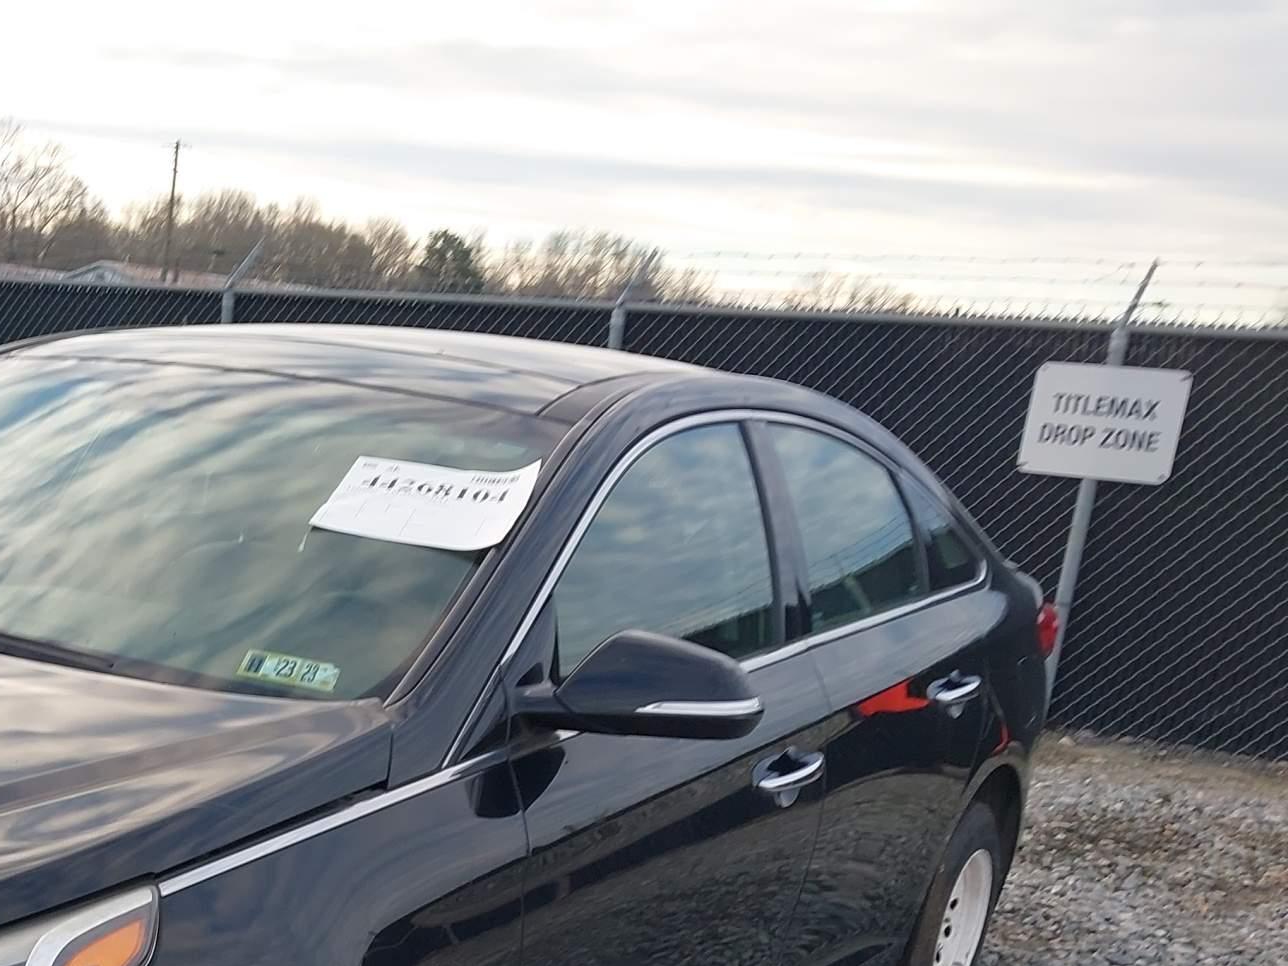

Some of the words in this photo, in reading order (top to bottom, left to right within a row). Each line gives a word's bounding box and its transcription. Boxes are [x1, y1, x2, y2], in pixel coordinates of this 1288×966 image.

[1053, 392, 1161, 421] TITLEMAX
[1038, 422, 1096, 446] DROP
[1098, 427, 1162, 453] ZONE
[361, 474, 510, 503] 44268104
